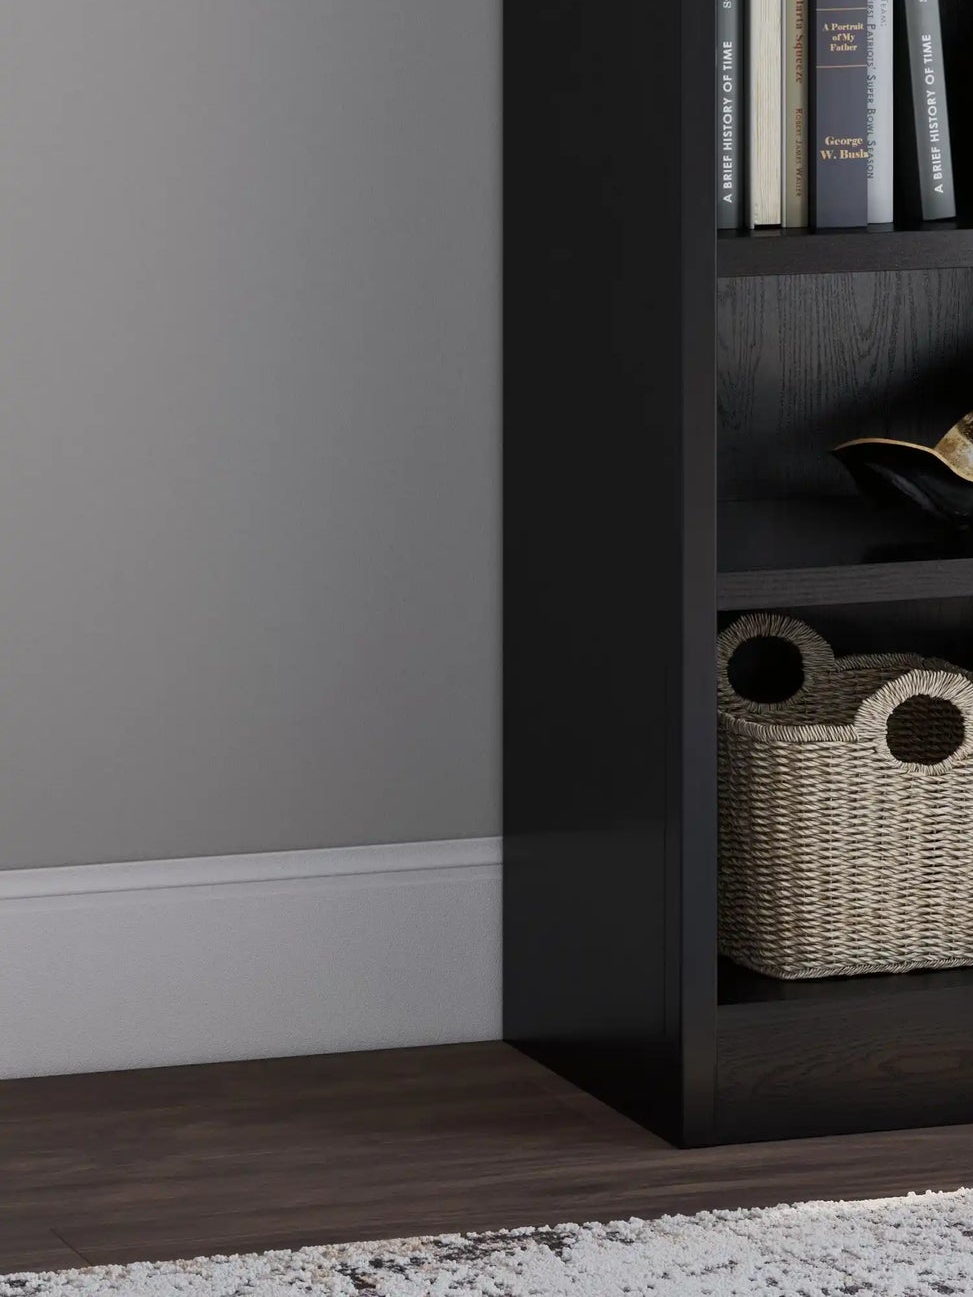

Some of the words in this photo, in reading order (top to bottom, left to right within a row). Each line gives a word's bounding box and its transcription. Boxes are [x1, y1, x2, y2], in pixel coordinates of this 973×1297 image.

[823, 23, 829, 31] A
[831, 22, 864, 31] Portrait
[832, 33, 841, 42] of
[842, 33, 855, 42] My
[722, 41, 733, 72] TIME
[830, 43, 858, 52] Father
[921, 34, 933, 64] TIME
[793, 33, 804, 84] Squeeze
[722, 75, 733, 93] OF
[924, 67, 935, 85] OF
[722, 98, 733, 151] HISTORY
[926, 90, 940, 142] HISTORY
[824, 136, 864, 148] George
[820, 150, 837, 160] W.
[840, 149, 869, 159] Bush
[931, 146, 943, 180] BRIEF
[722, 155, 733, 189] BRIEF
[934, 183, 944, 194] A
[722, 193, 733, 203] A
